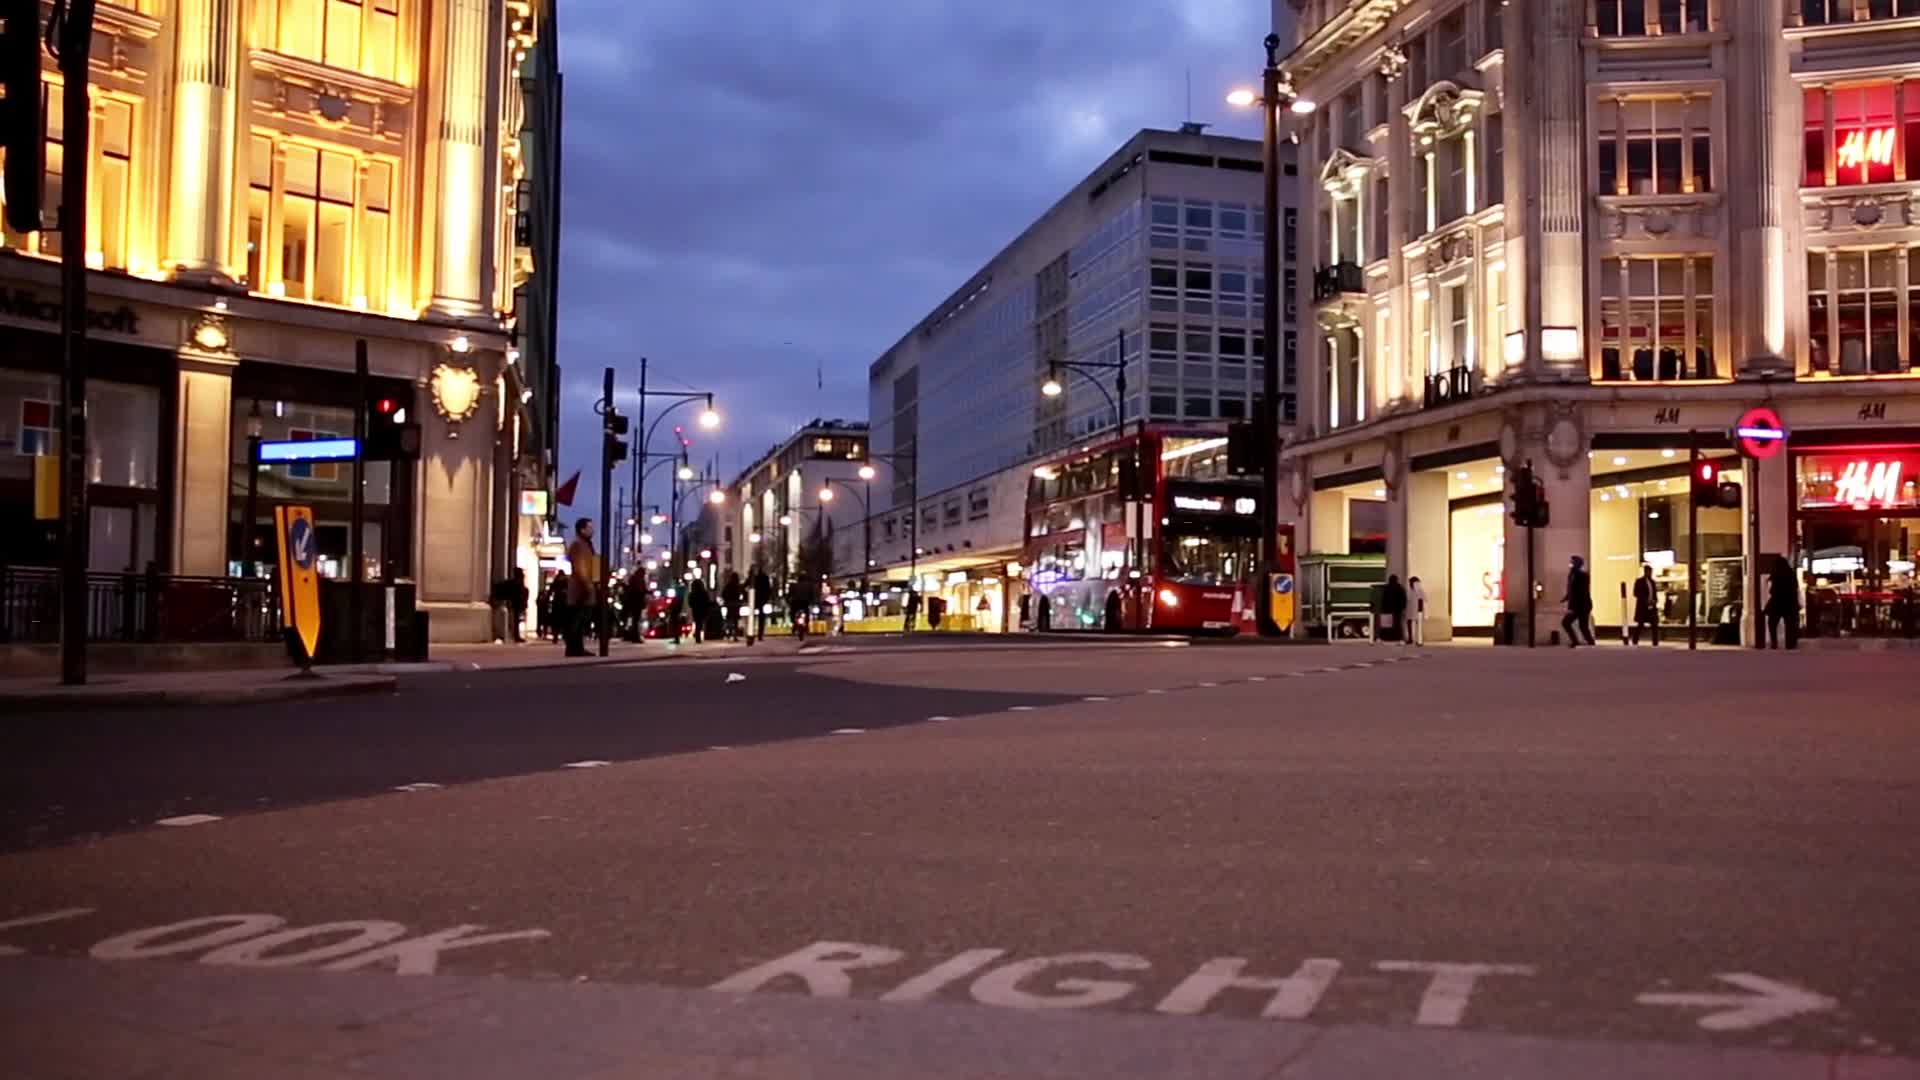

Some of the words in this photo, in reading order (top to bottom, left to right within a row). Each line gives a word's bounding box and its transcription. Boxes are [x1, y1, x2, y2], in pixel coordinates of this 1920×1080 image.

[0, 286, 138, 334] Micrsoft
[1834, 460, 1902, 504] H&M
[704, 940, 1536, 1028] RIGHT
